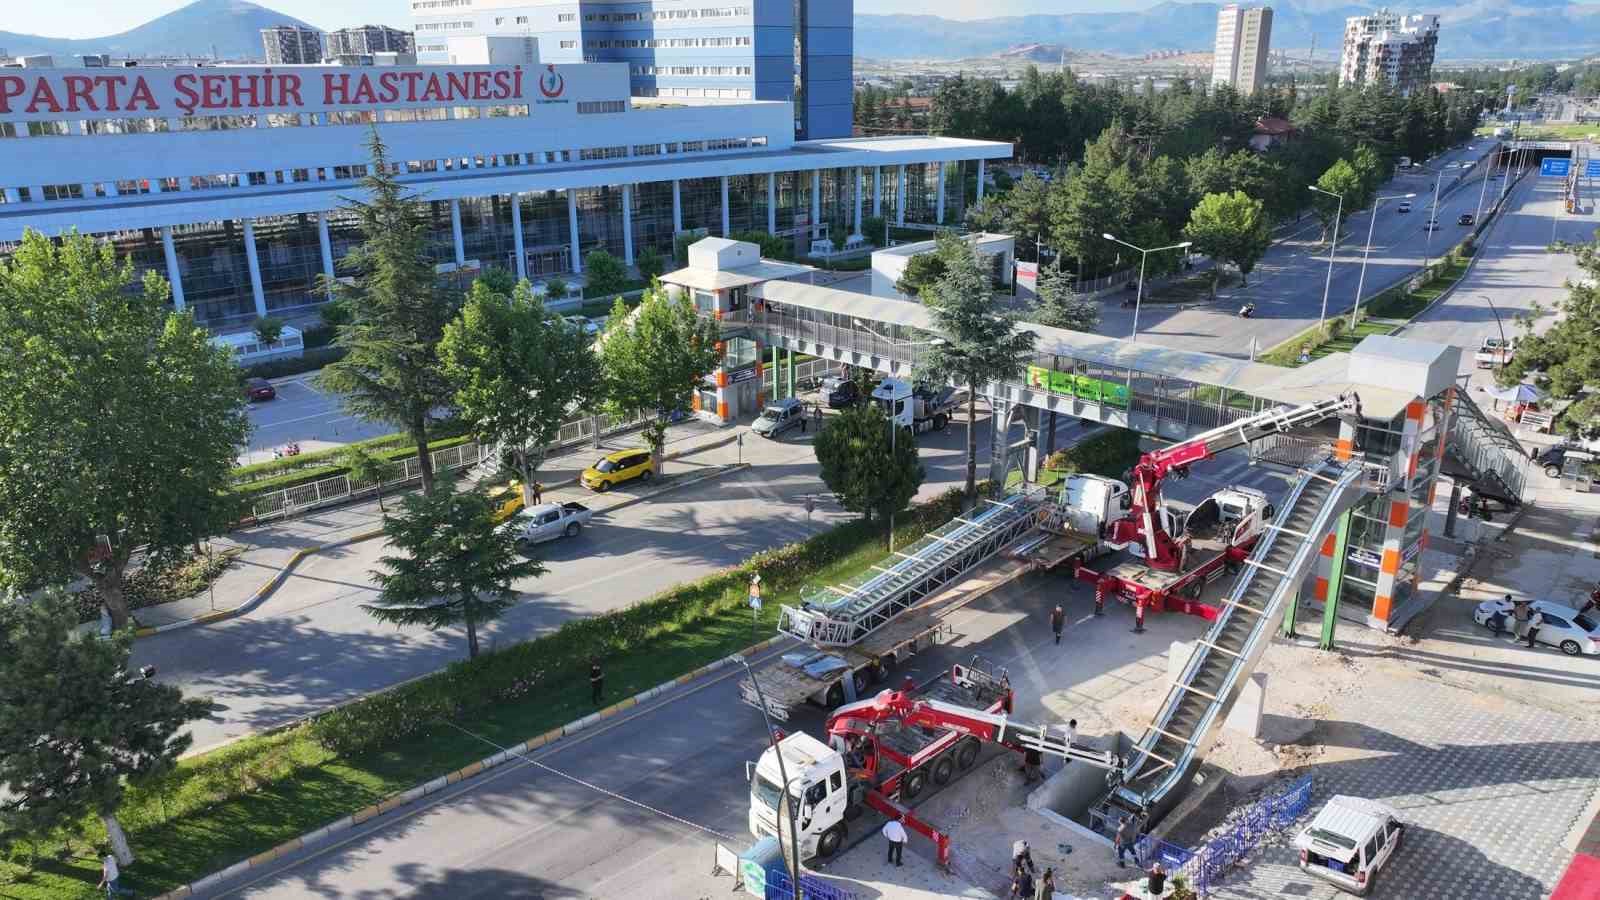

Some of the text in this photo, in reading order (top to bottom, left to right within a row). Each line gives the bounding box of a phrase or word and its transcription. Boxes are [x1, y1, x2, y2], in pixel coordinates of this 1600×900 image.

[0, 65, 523, 115] PARTA ŞEHİR HASTANESİ
